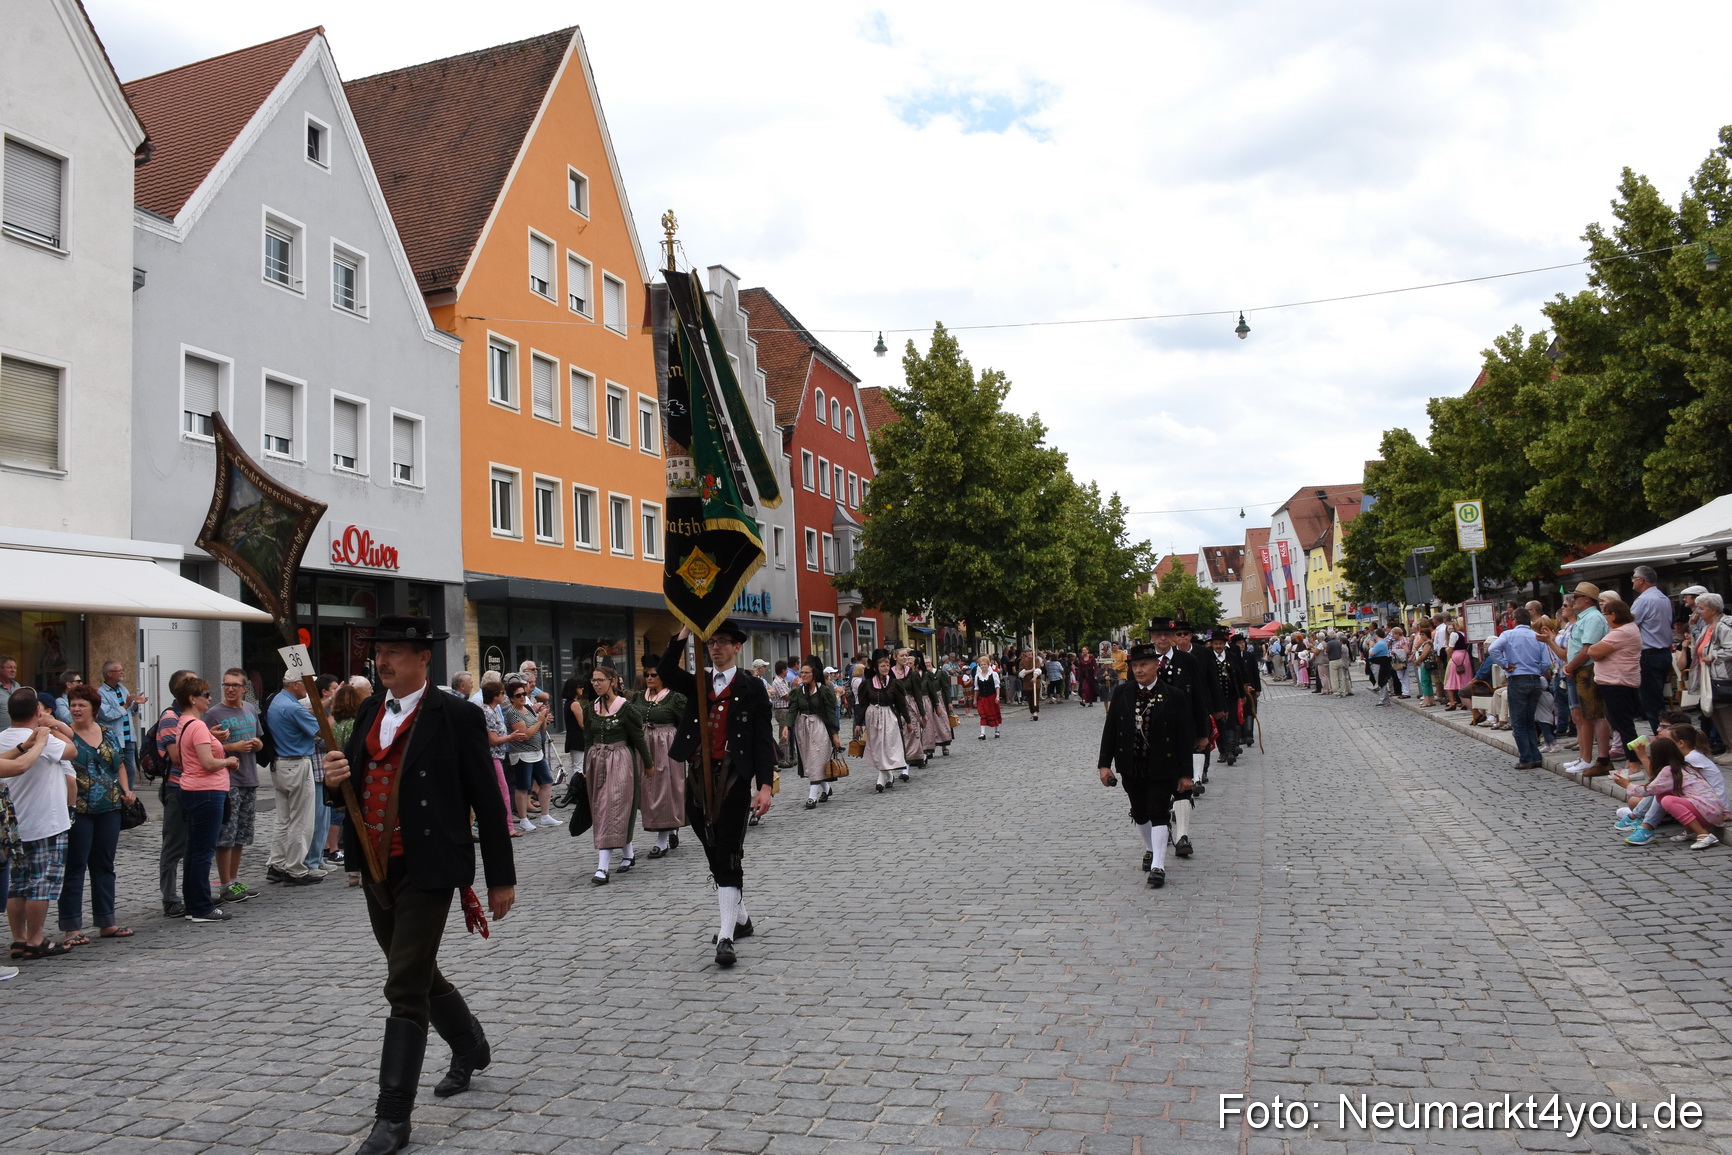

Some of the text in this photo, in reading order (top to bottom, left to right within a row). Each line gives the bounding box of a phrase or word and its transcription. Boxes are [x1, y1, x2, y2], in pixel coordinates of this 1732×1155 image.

[234, 455, 292, 505] Trachtenverein
[1463, 507, 1475, 519] H
[331, 524, 401, 570] s.Oliver
[171, 621, 178, 630] 29
[288, 652, 303, 668] 36
